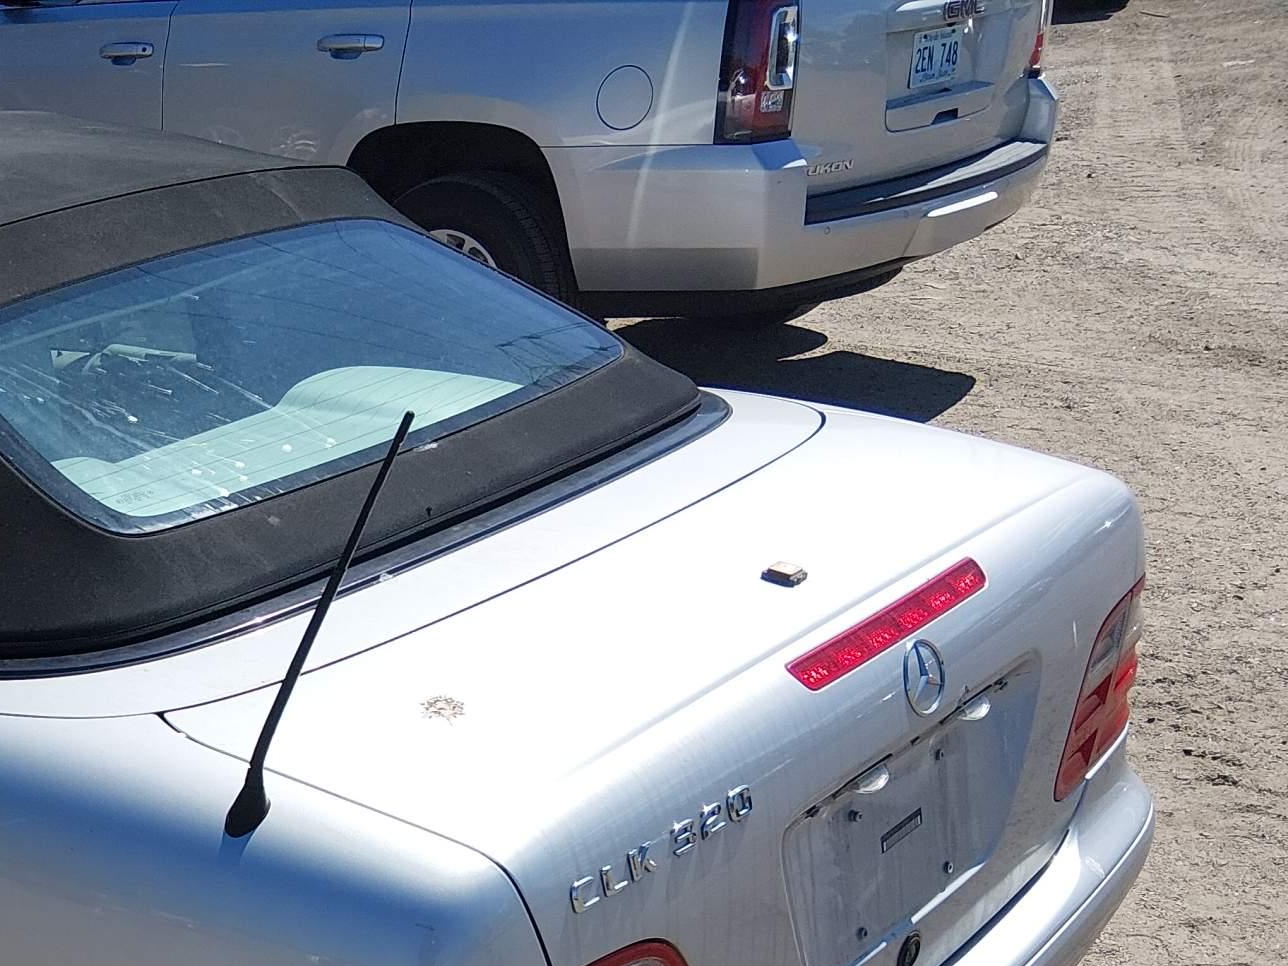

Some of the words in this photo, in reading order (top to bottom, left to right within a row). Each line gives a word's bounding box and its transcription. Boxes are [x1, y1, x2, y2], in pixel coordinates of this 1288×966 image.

[943, 0, 985, 21] GMC
[915, 45, 935, 74] 2EN
[940, 41, 959, 68] 748
[806, 159, 855, 177] UKON
[569, 841, 657, 914] CLK
[669, 784, 753, 857] 320
